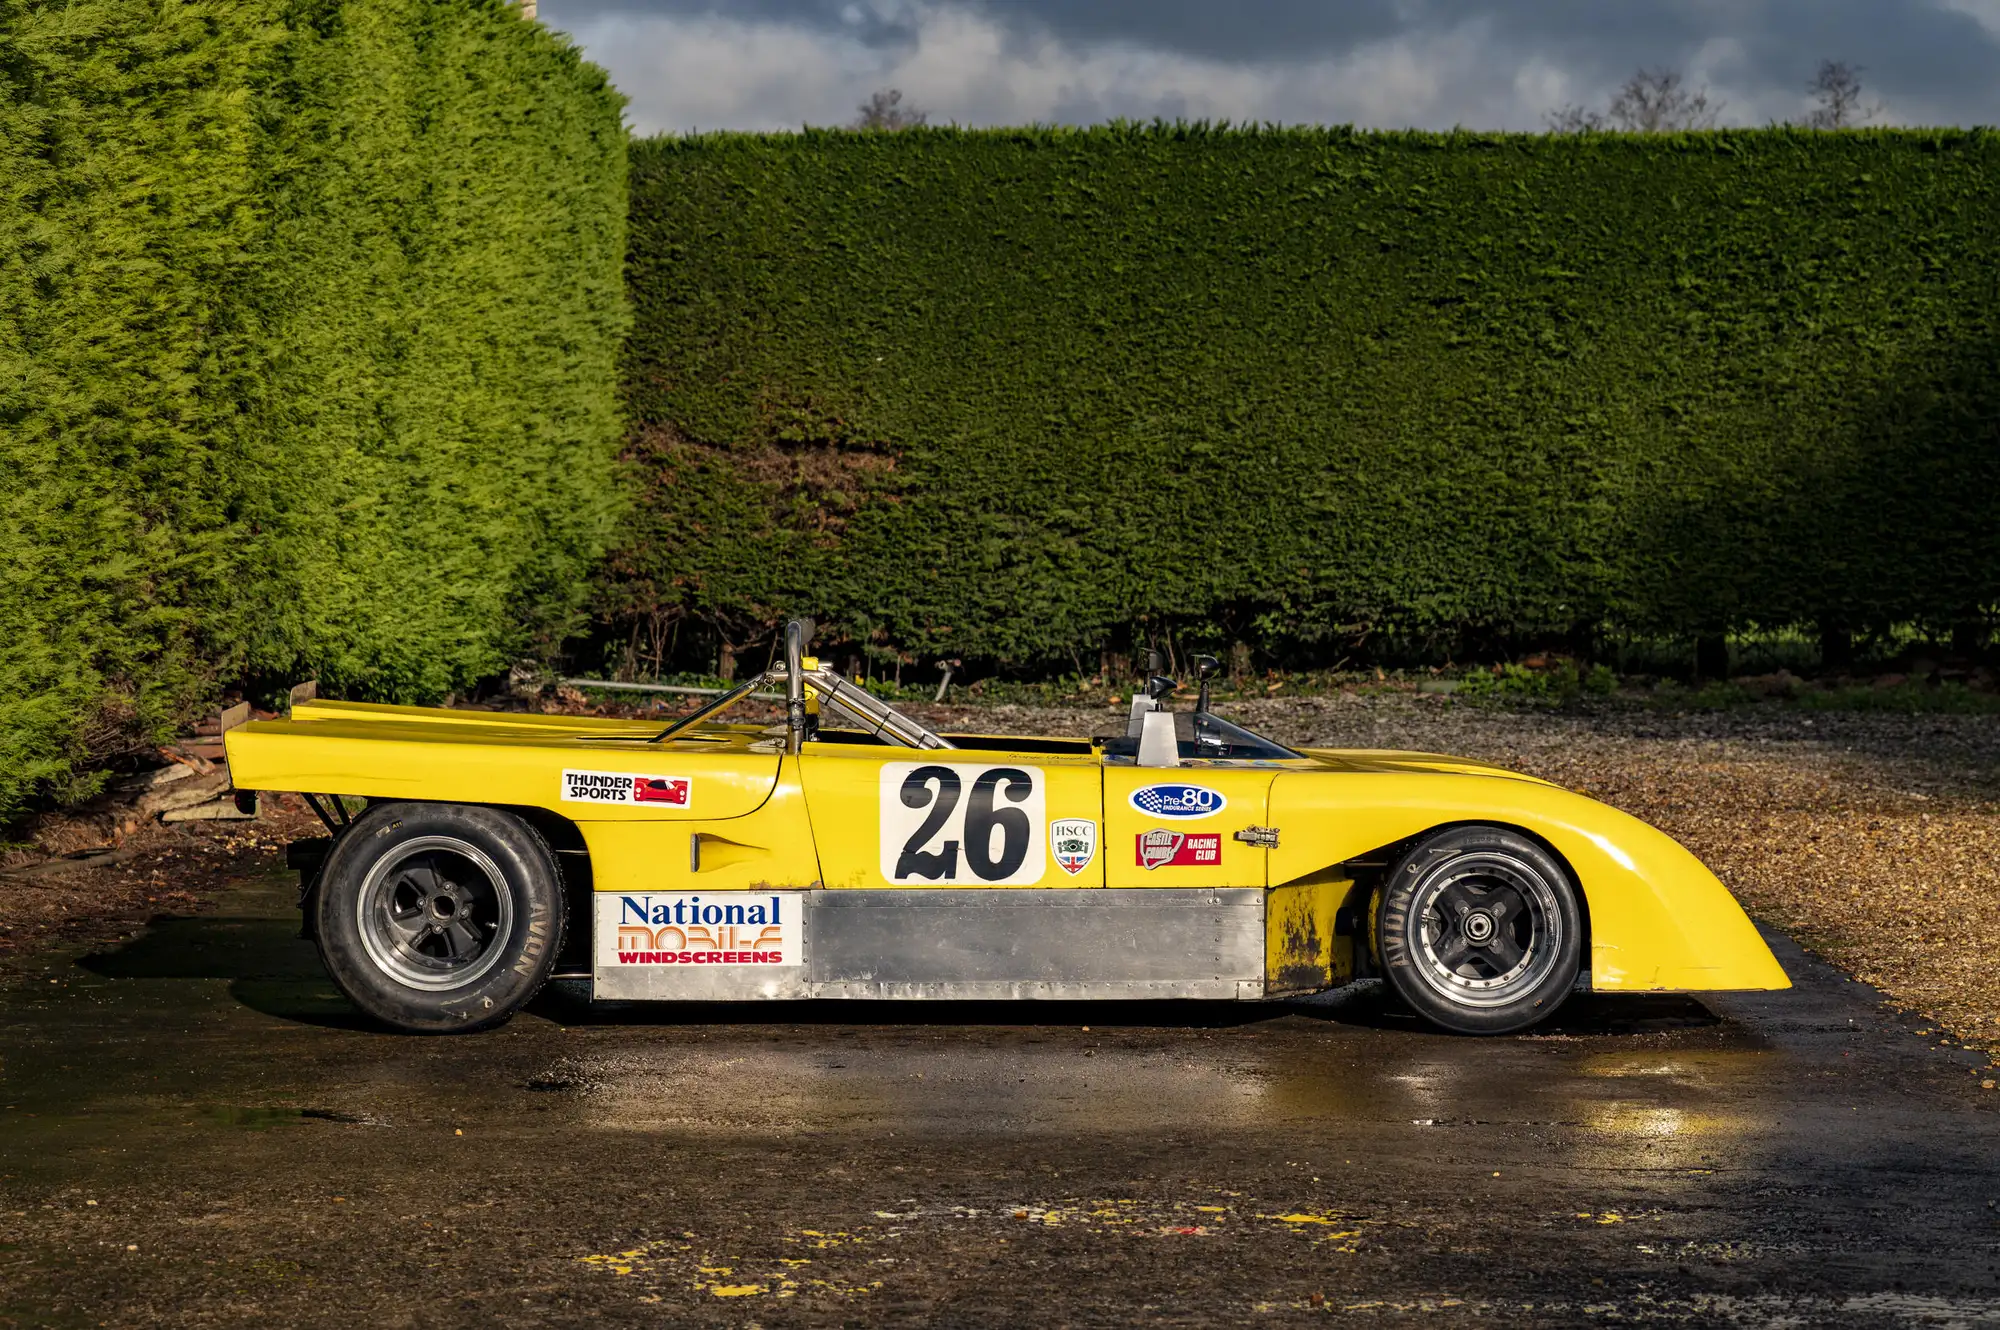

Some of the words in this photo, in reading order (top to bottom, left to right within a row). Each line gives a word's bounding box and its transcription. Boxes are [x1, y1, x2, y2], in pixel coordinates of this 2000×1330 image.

[566, 773, 633, 789] THUNDER
[570, 786, 627, 801] SPORTS
[1163, 788, 1213, 806] Pre-80
[895, 765, 1033, 881] 26
[1056, 825, 1092, 836] HSCC
[1146, 832, 1173, 846] CASTLE
[1187, 838, 1218, 850] RACING
[1195, 850, 1217, 861] CLUB
[618, 896, 783, 925] National
[1384, 889, 1410, 967] AVON
[513, 902, 548, 977] AVON
[618, 951, 783, 964] WINDSCREENS
